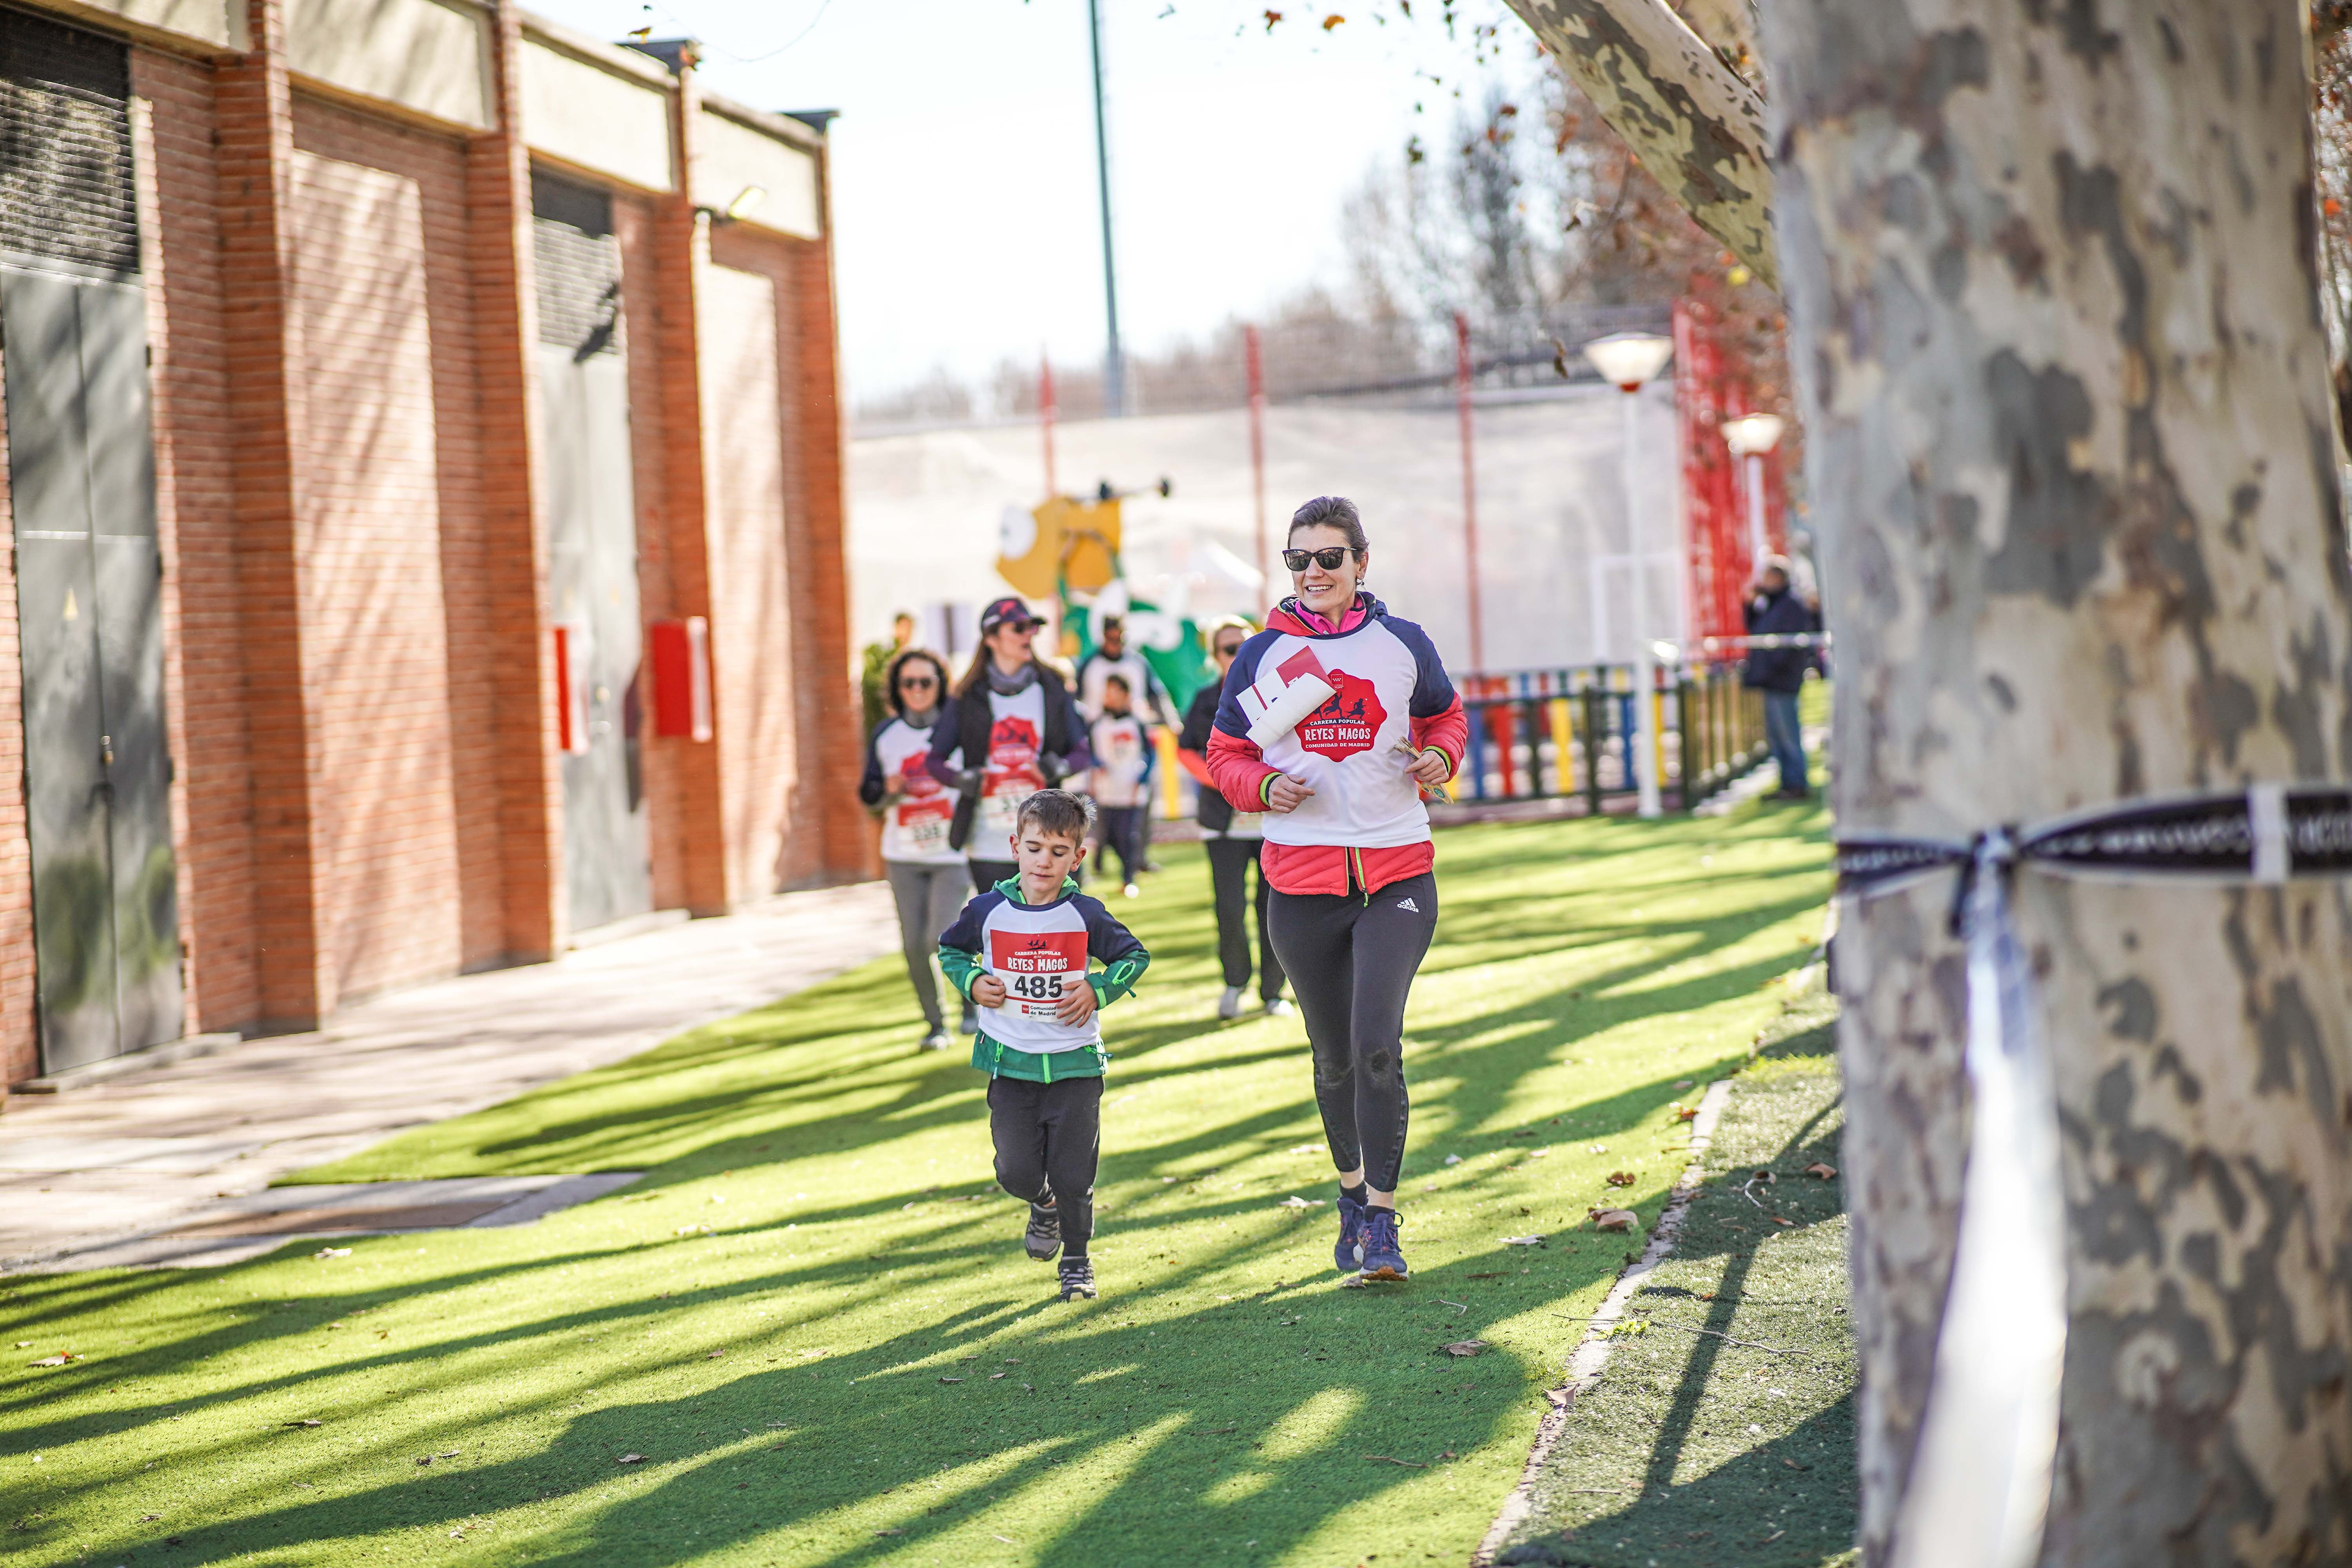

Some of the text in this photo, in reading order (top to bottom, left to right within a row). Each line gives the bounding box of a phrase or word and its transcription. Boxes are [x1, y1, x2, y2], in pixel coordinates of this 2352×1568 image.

[1305, 728, 1371, 741] REYES MAGOS
[1397, 903, 1419, 913] adidas
[1007, 956, 1067, 972] REYES MAGOS
[1014, 975, 1063, 998] 485
